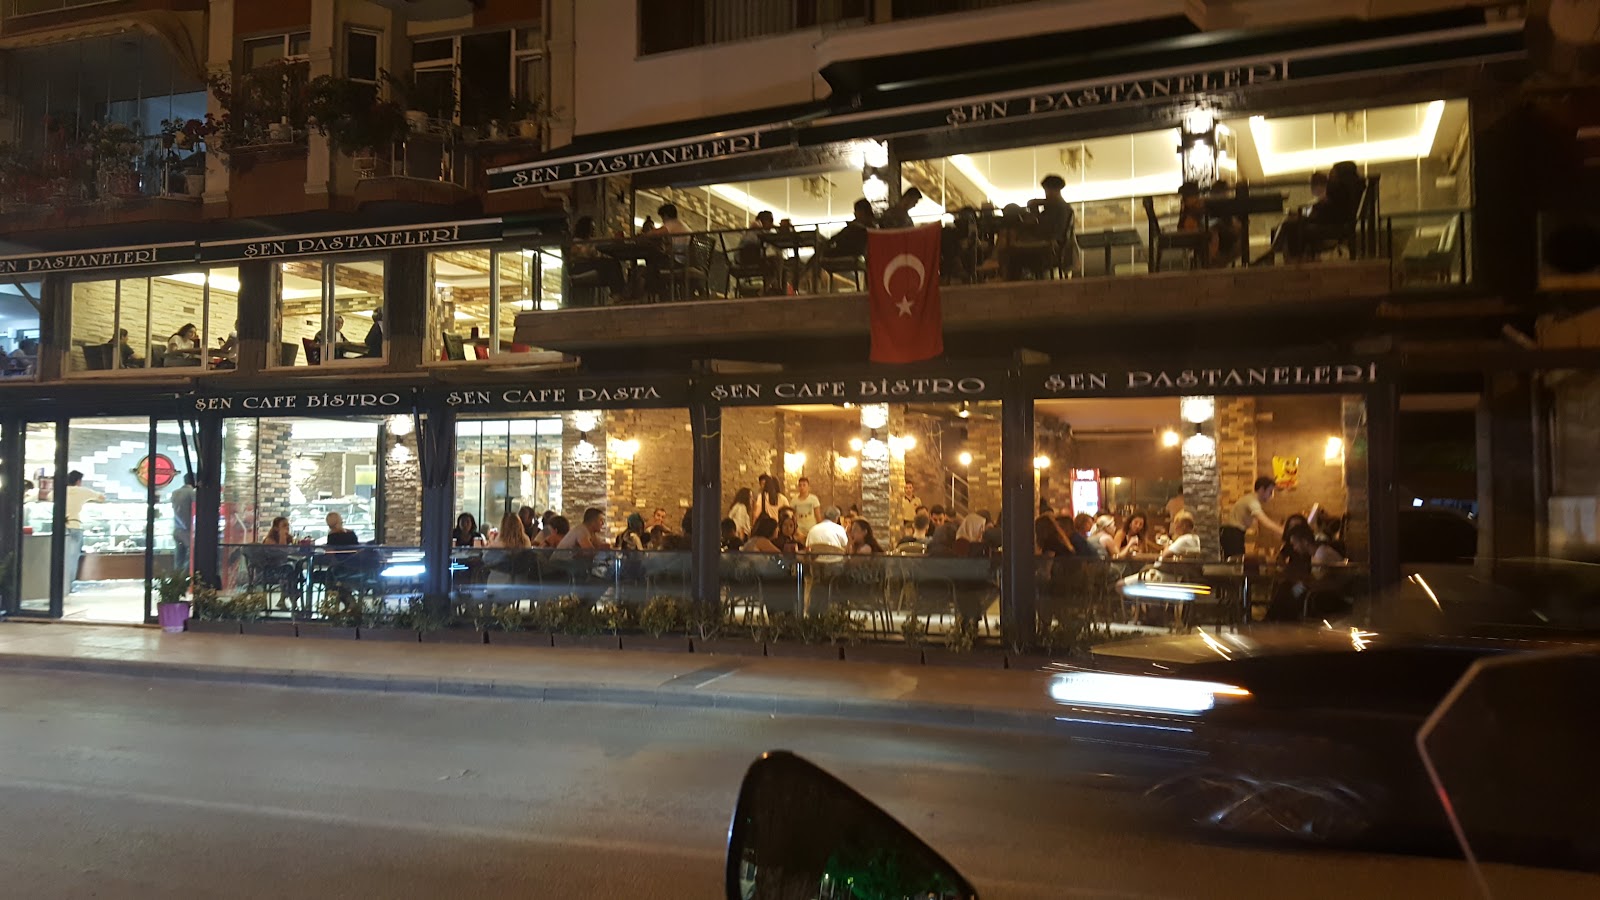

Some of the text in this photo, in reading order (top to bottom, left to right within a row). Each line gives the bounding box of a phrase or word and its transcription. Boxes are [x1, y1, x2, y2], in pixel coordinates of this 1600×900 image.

[244, 225, 461, 259] ŞEN PASTANELERİ
[0, 247, 157, 273] EN PASTANELERİ
[709, 377, 986, 400] ŞEN CAFE BİSTRO
[1045, 373, 1107, 392] ŞEN
[195, 392, 400, 411] ŞEN CAFE BİSTRO
[446, 386, 661, 406] ŞEN CAFE PASTA
